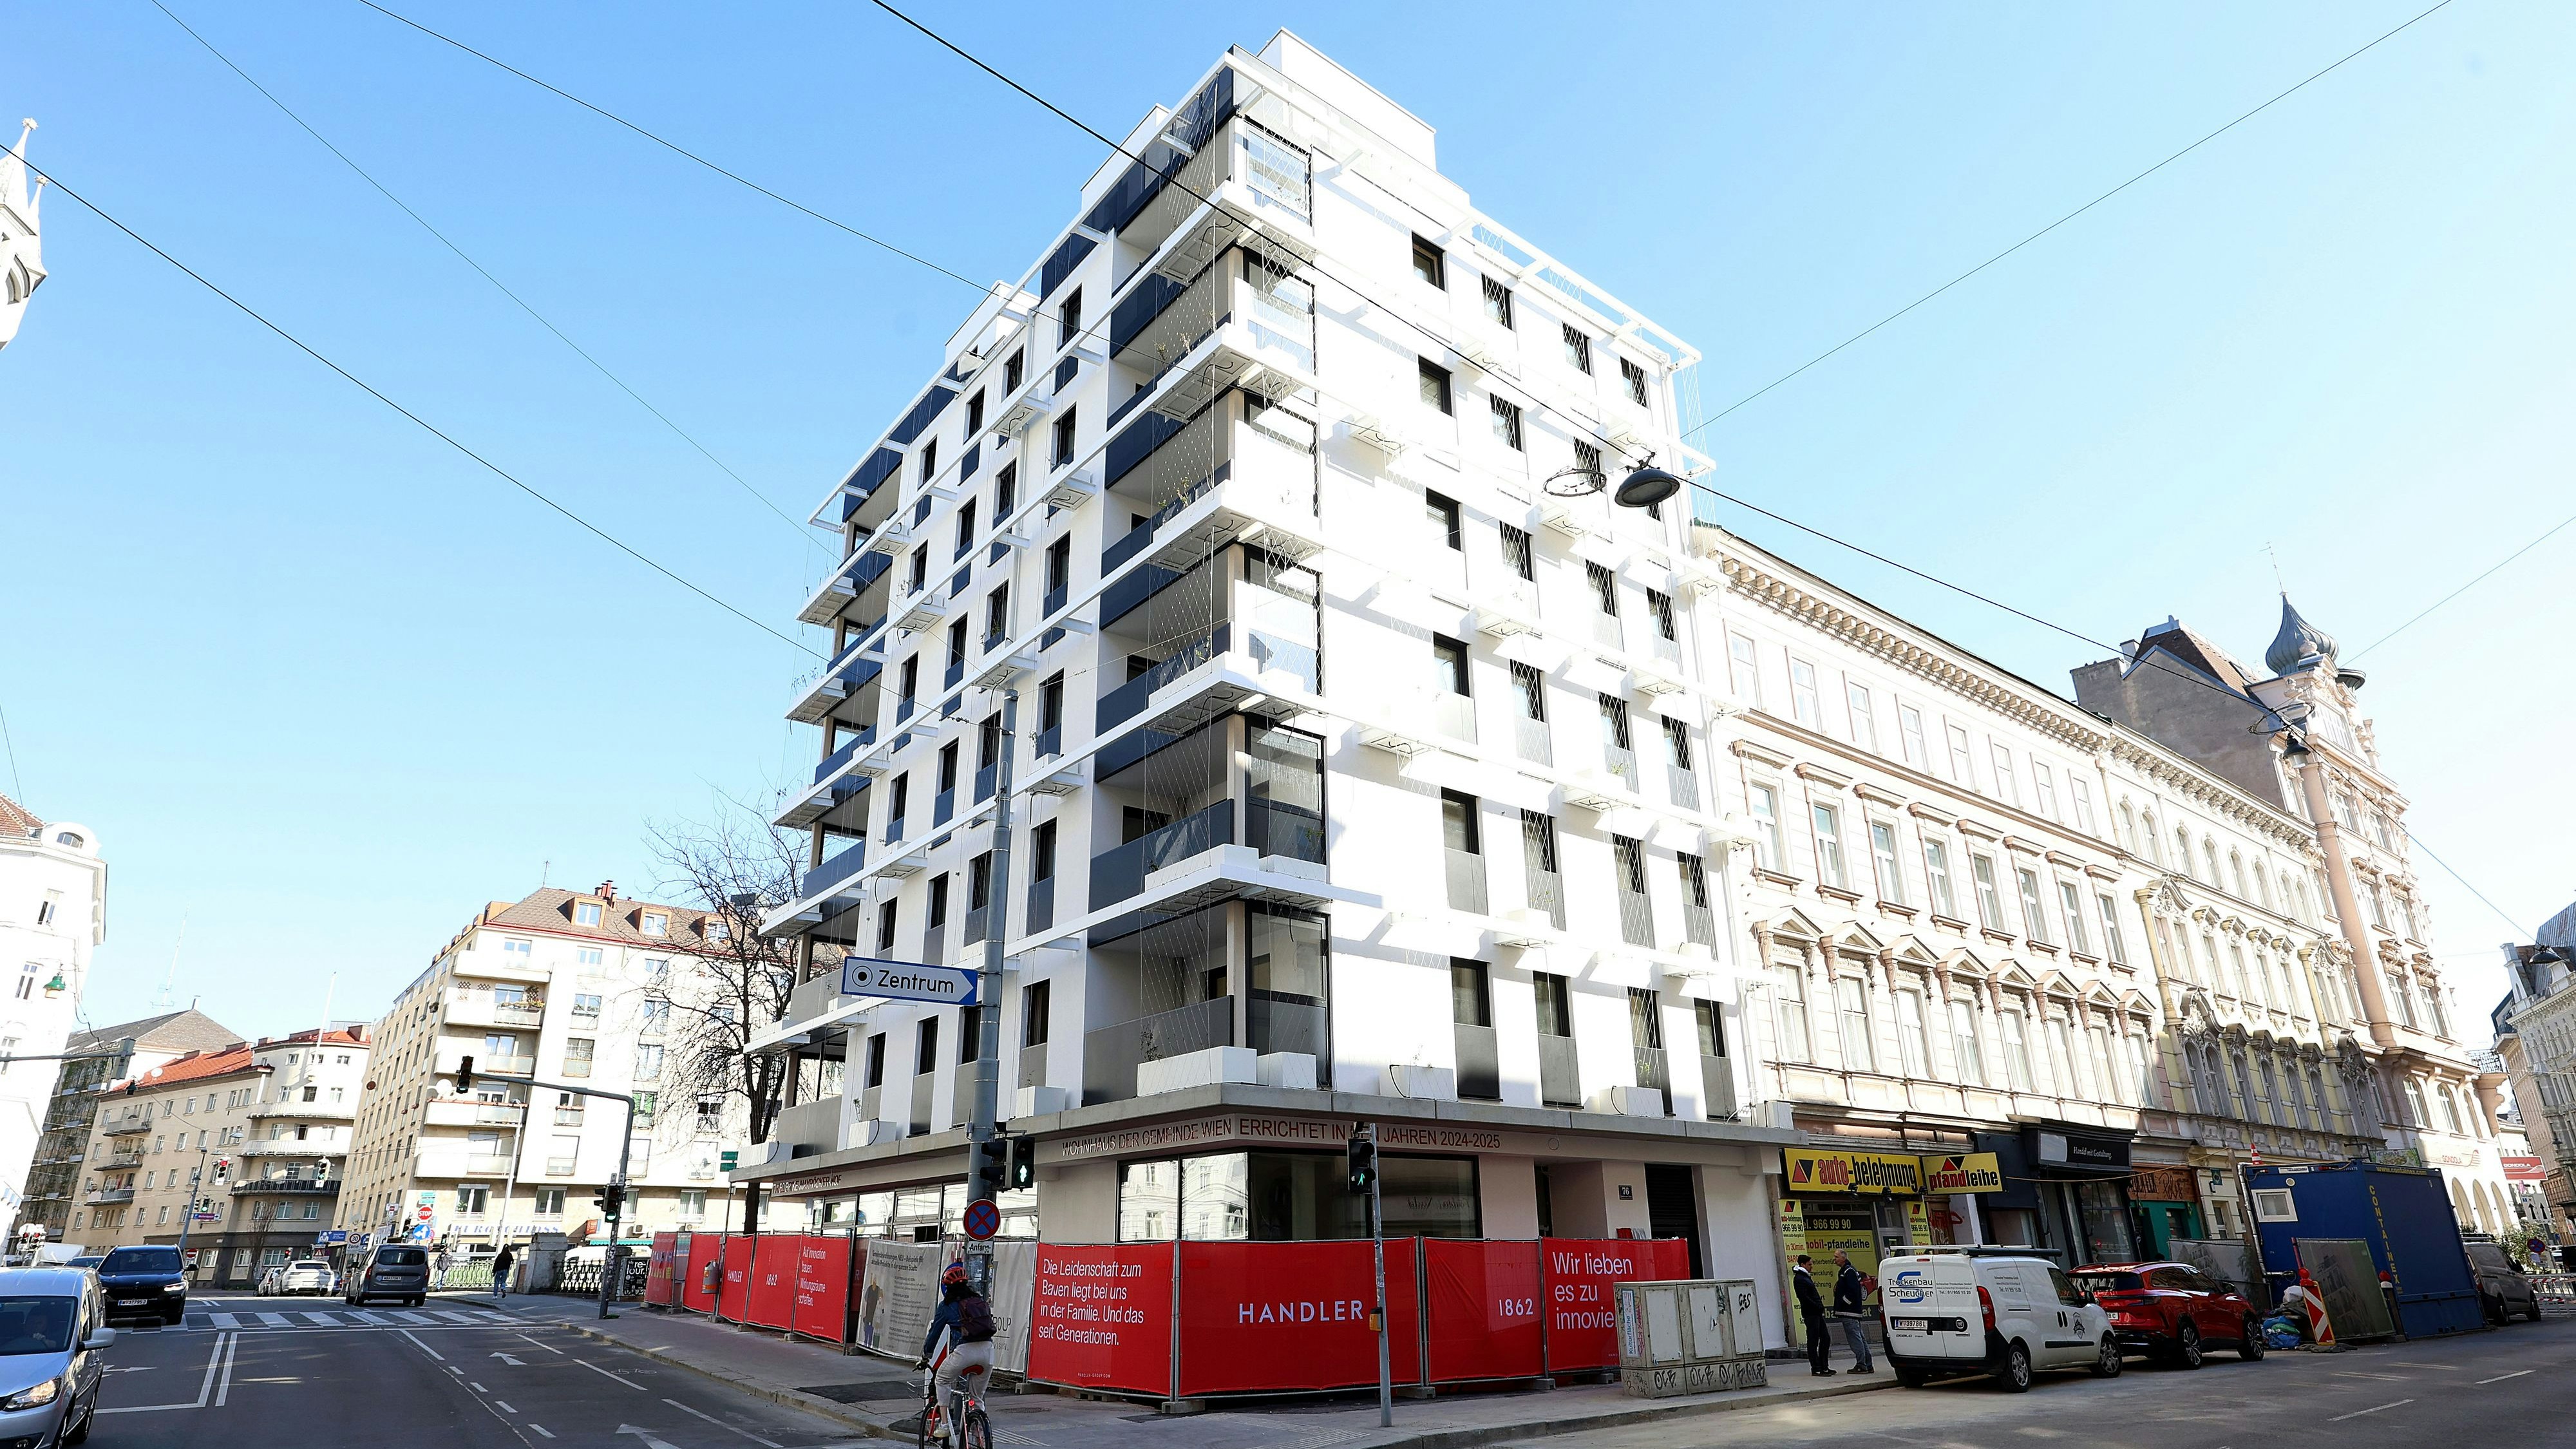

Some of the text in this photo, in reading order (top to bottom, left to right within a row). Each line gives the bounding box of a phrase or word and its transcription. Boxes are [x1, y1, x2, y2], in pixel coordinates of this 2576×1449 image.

[878, 969, 954, 994] Zentrum
[1062, 1136, 1116, 1157] WOHNHAUS
[1119, 1133, 1139, 1149] DER
[1142, 1123, 1198, 1146] GEMEINDE
[1202, 1118, 1231, 1138] WIEN
[1240, 1118, 1327, 1139] ERRICHTET
[1332, 1124, 1345, 1140] IN
[1383, 1127, 1437, 1145] JAHREN
[1440, 1131, 1501, 1148] 2024-2025
[2074, 1146, 2087, 1155] Handel
[1818, 1156, 1918, 1191] auto-belehnung
[1928, 1169, 1999, 1191] pfandleihe
[1622, 1187, 1629, 1195] 76
[1783, 1224, 1803, 1232] 966 99 90
[1813, 1219, 1828, 1229] 966
[1830, 1219, 1839, 1229] 99
[1841, 1219, 1851, 1229] 90
[2369, 1185, 2400, 1284] CONTAINEX
[808, 1247, 826, 1260] Innovation
[1043, 1258, 1141, 1277] Die Leidenschaft zum
[1552, 1252, 1633, 1274] Wir lieben
[727, 1270, 743, 1283] HANDLER
[766, 1274, 779, 1286] 1862
[1888, 1278, 1933, 1287] Trockenbau
[1042, 1280, 1127, 1302] Bauen liegt bei uns
[1555, 1285, 1598, 1302] es zu
[1889, 1287, 1933, 1297] Scheucher
[1040, 1301, 1144, 1323] in der Familie. Und das
[1239, 1300, 1363, 1323] HANDLER
[1499, 1298, 1534, 1316] 1862
[1038, 1323, 1119, 1345] seit Generationen.
